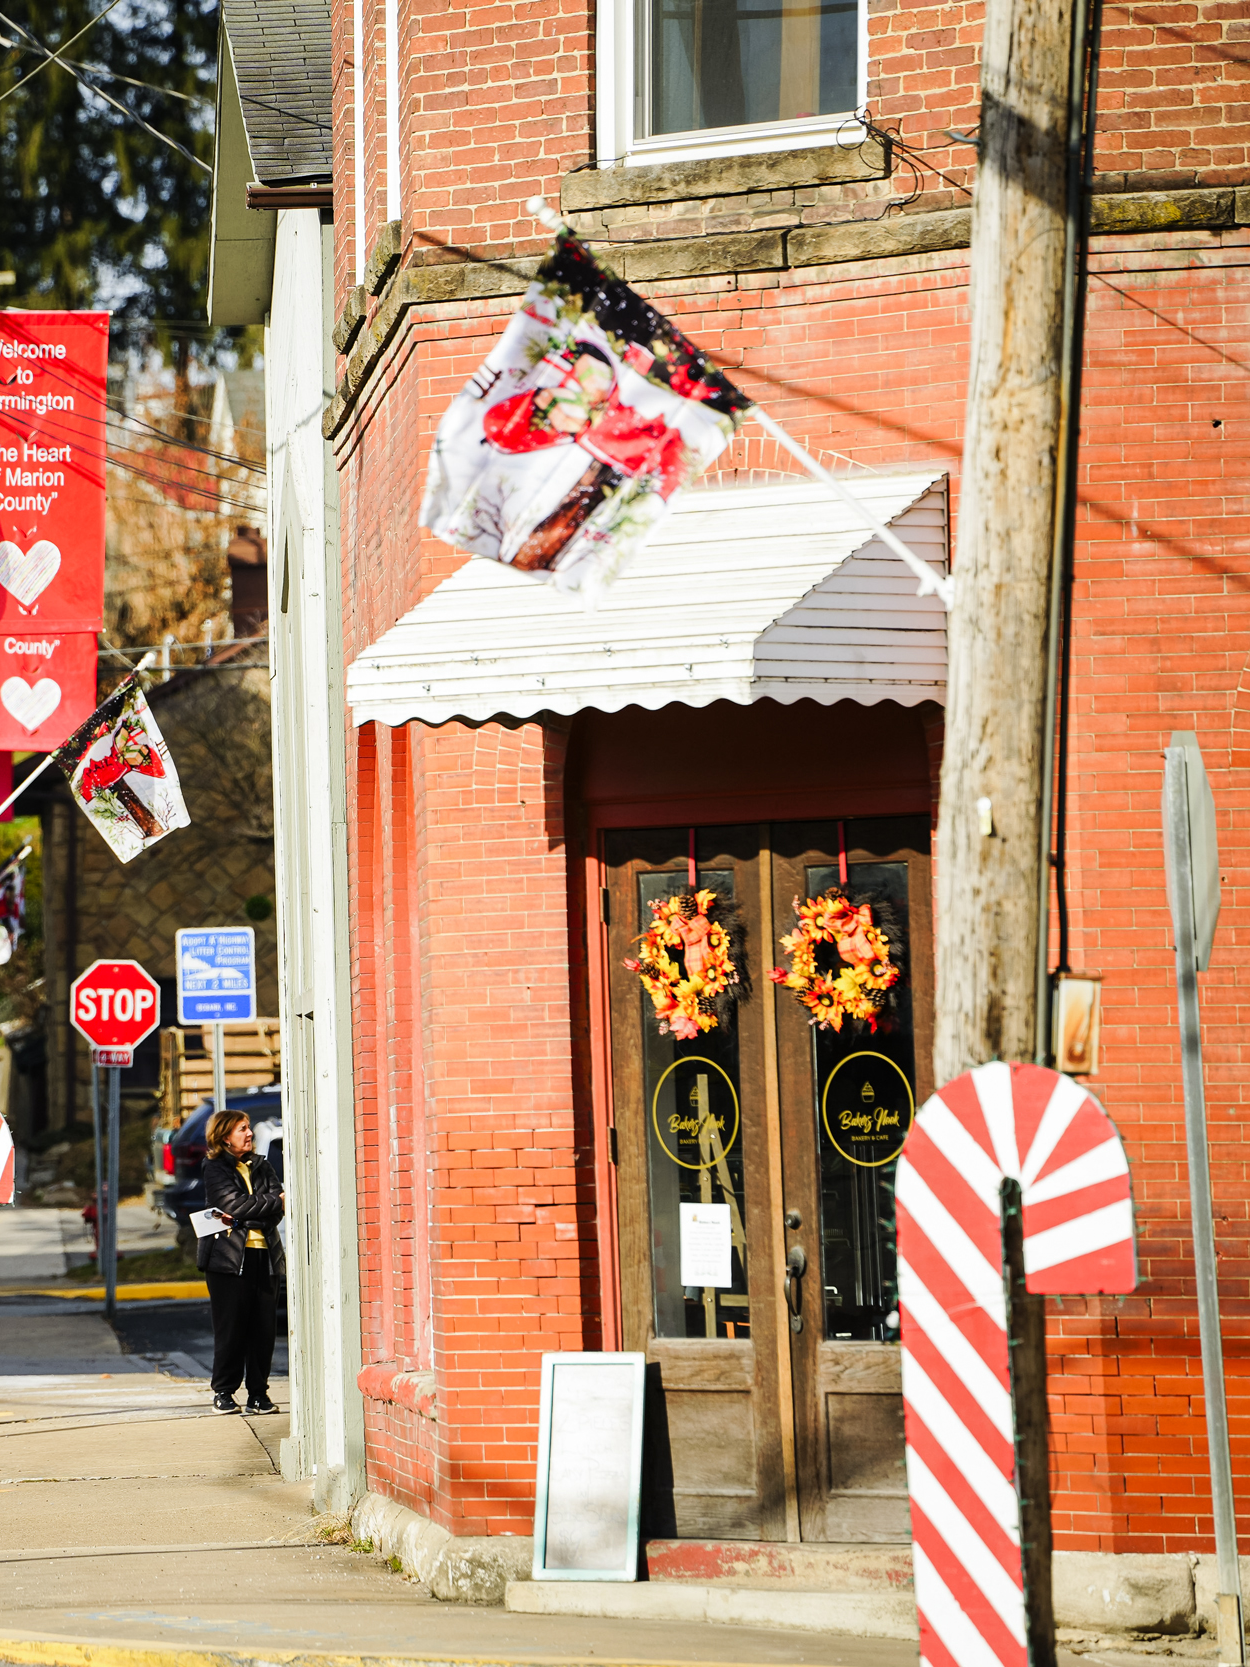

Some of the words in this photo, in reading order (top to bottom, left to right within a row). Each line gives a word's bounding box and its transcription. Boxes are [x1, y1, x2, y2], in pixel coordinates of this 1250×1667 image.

[16, 366, 34, 384] to
[23, 444, 71, 462] Heart
[6, 468, 64, 486] Marion
[184, 980, 206, 989] NEXT
[212, 979, 219, 989] 2
[222, 978, 248, 988] MILES
[77, 987, 154, 1022] STOP
[874, 1107, 900, 1131] Nook
